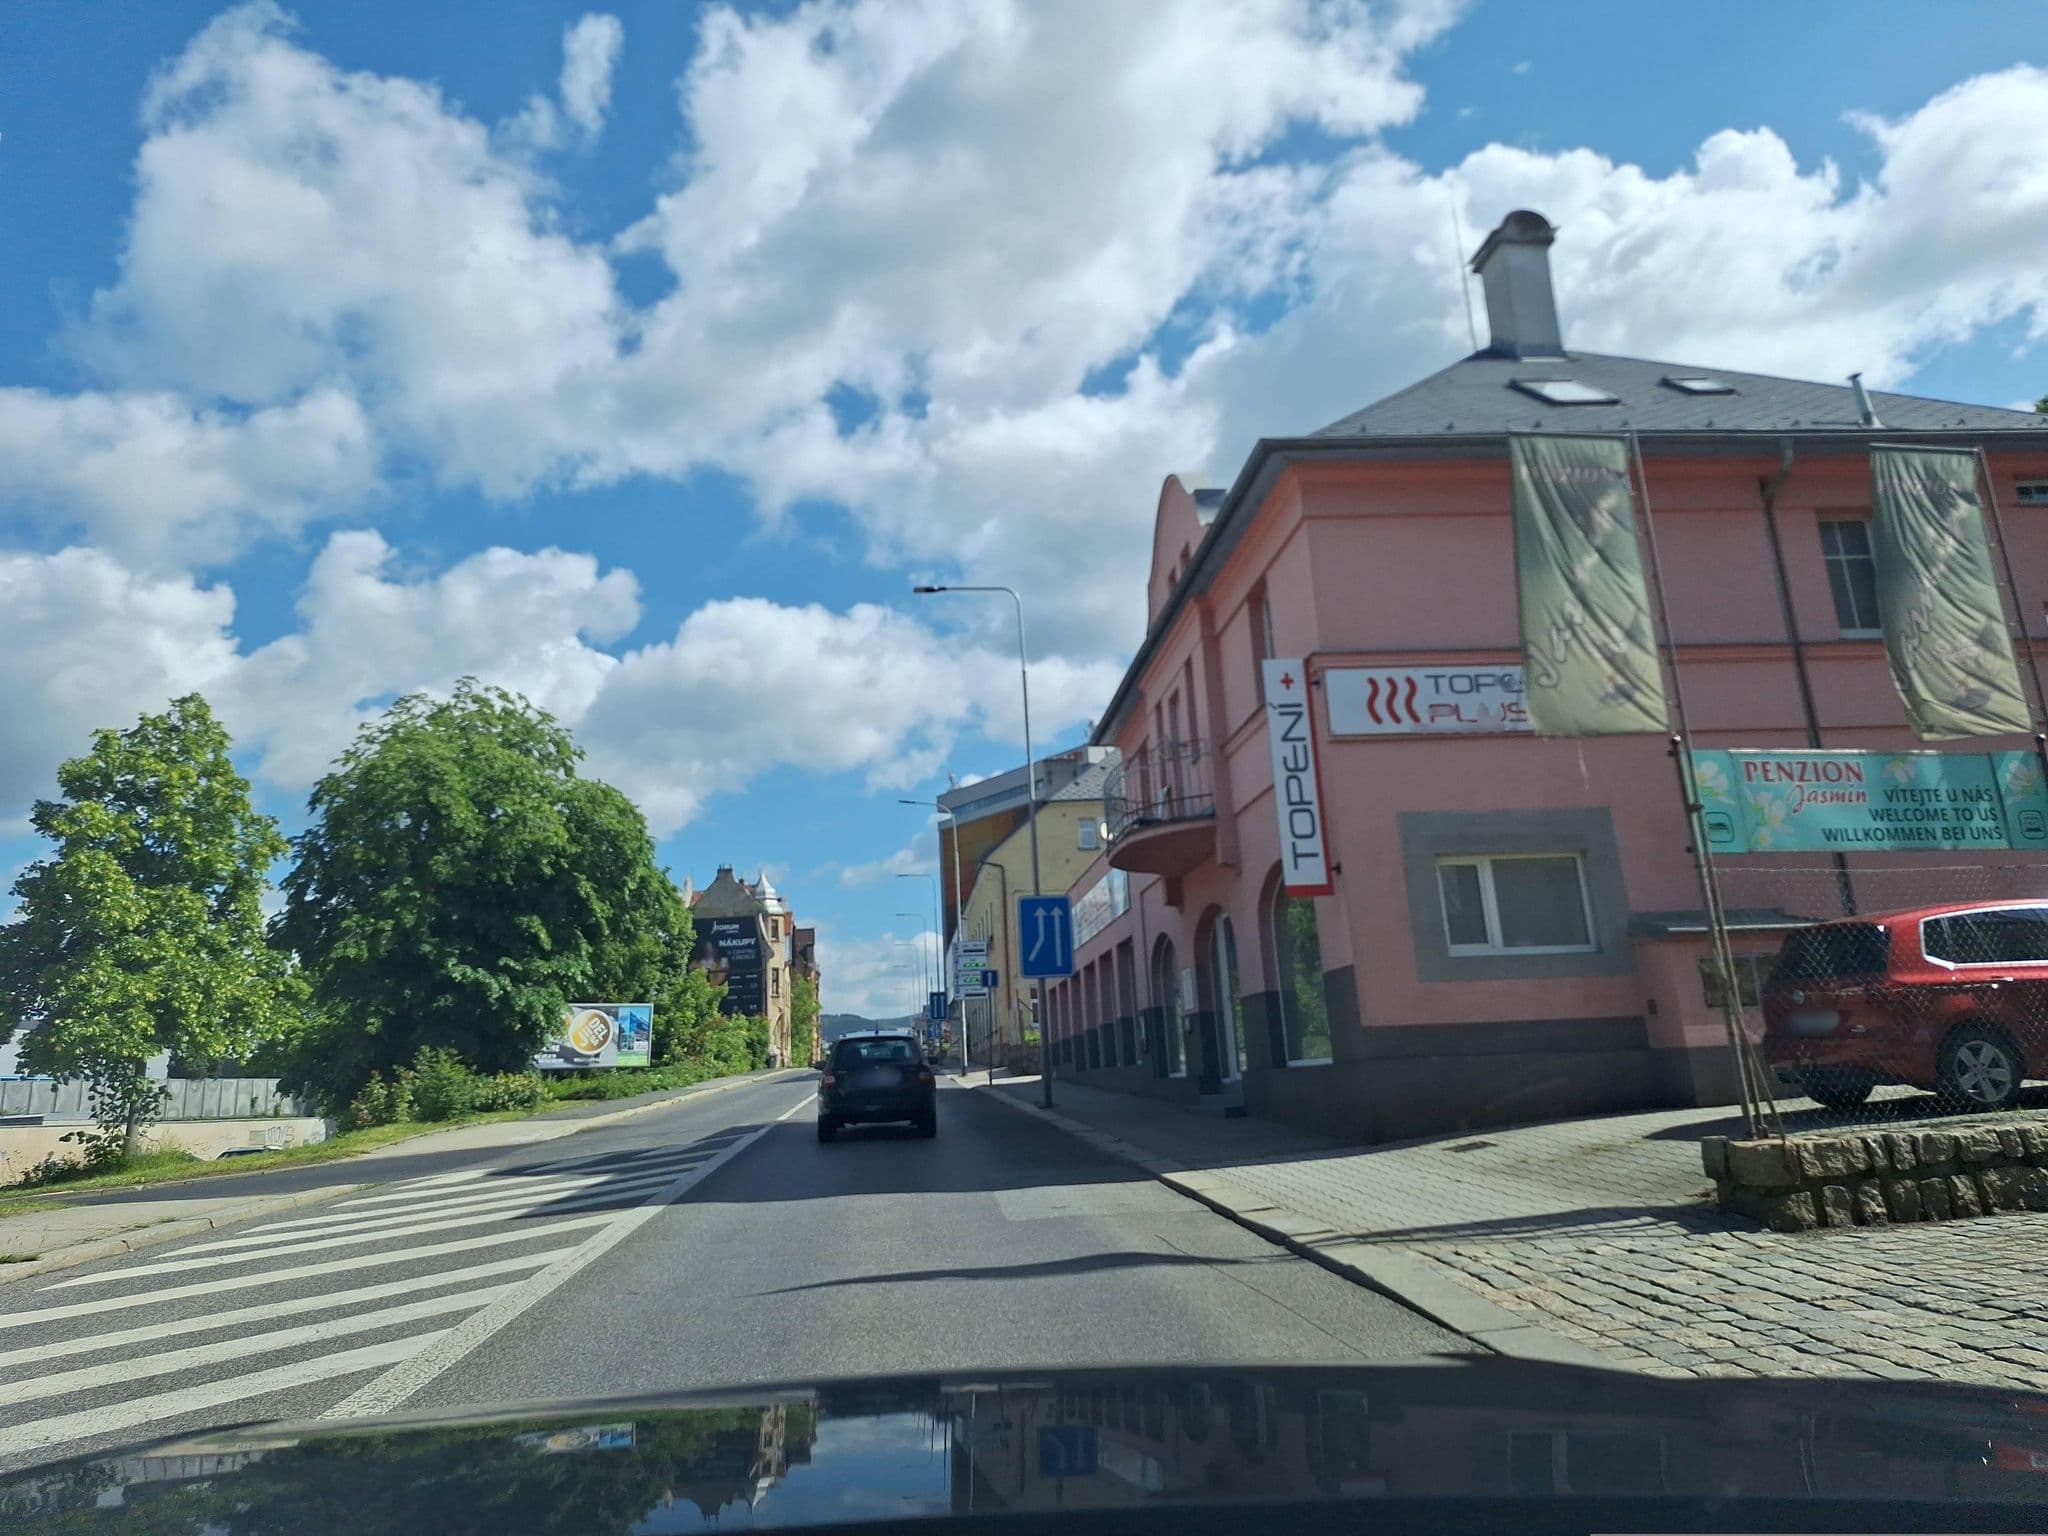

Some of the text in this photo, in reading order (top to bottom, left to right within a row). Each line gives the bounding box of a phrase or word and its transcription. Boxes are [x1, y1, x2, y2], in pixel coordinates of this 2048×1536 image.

[1744, 760, 1864, 783] PENZION
[1270, 701, 1320, 870] TOPENÍ
[1883, 784, 1993, 804] VÍTEJTE U NÁS
[1868, 807, 1999, 823] WELCOME TO US
[1822, 826, 2003, 844] WILLKOMMEN BEI UNS
[719, 937, 756, 947] NÁKUPY
